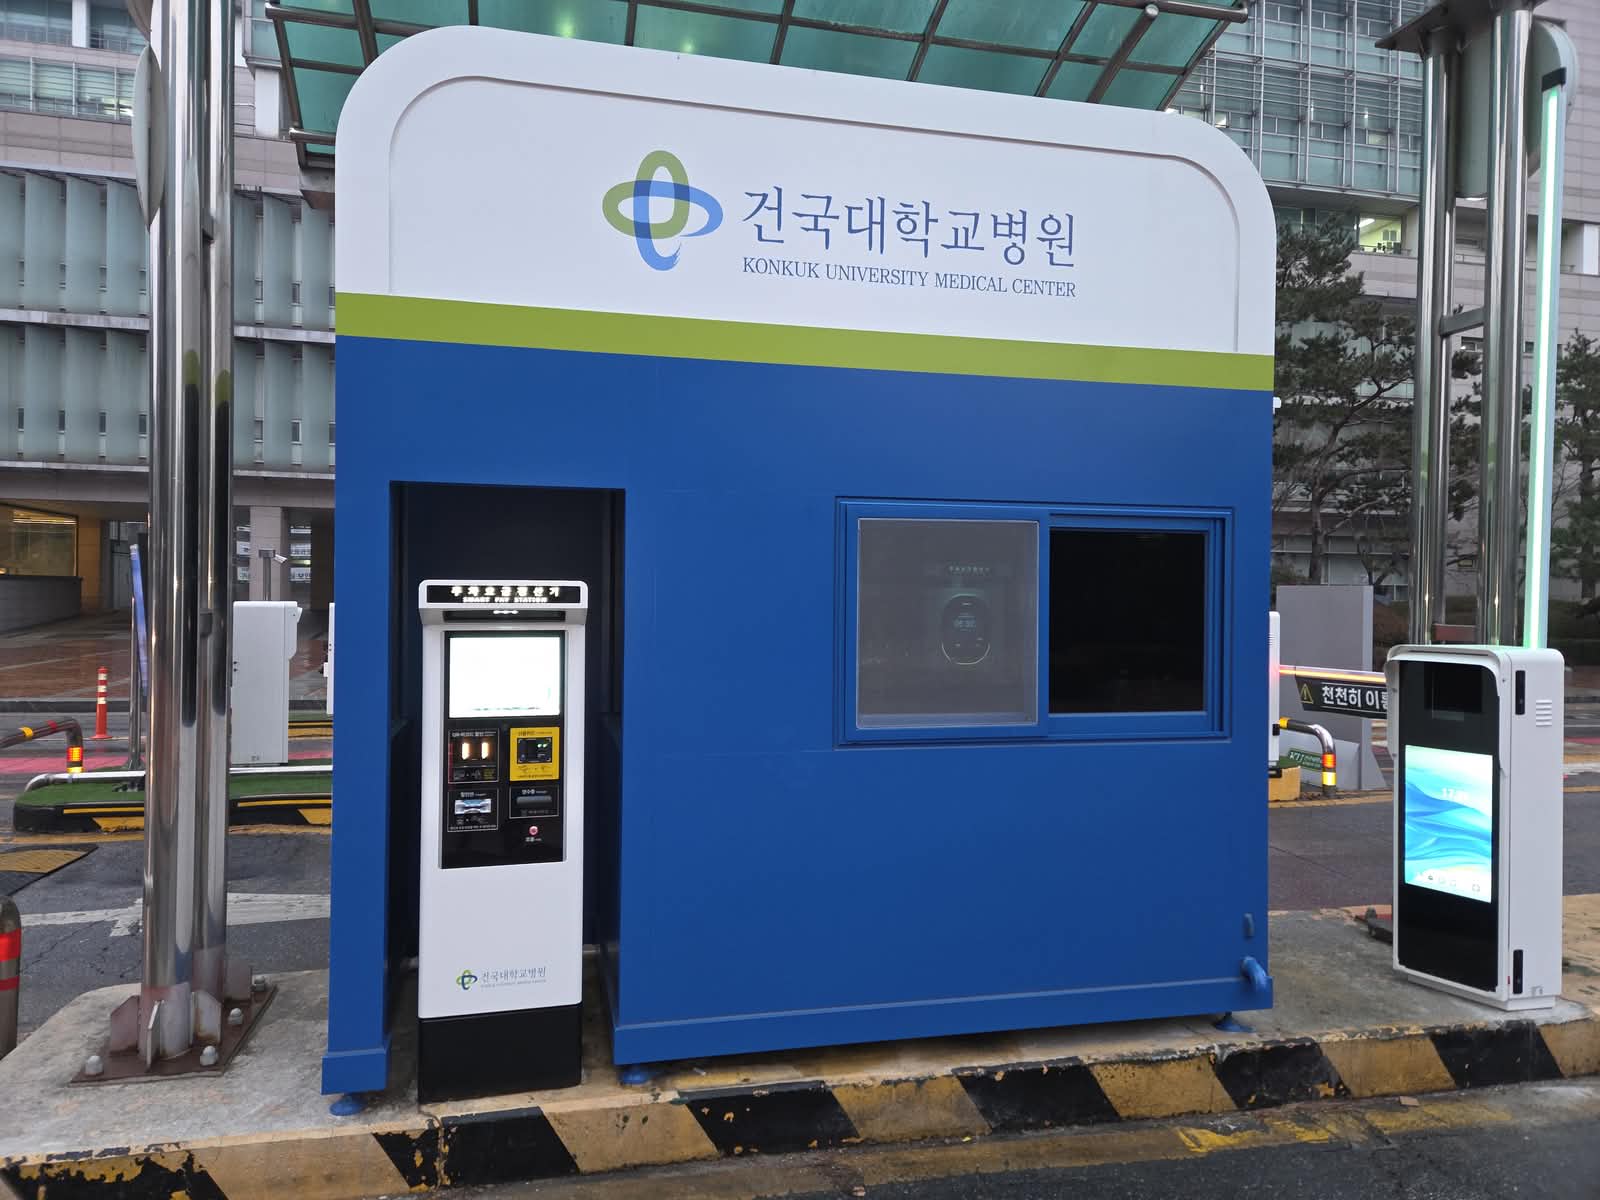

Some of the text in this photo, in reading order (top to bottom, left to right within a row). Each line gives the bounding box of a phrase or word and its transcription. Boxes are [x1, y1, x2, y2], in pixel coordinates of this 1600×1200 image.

[742, 185, 1076, 268] 건국대학교병원
[742, 256, 1076, 298] KONKUK UNIVERSITY MEDICAL CENTER
[1321, 685, 1362, 708] 천천히
